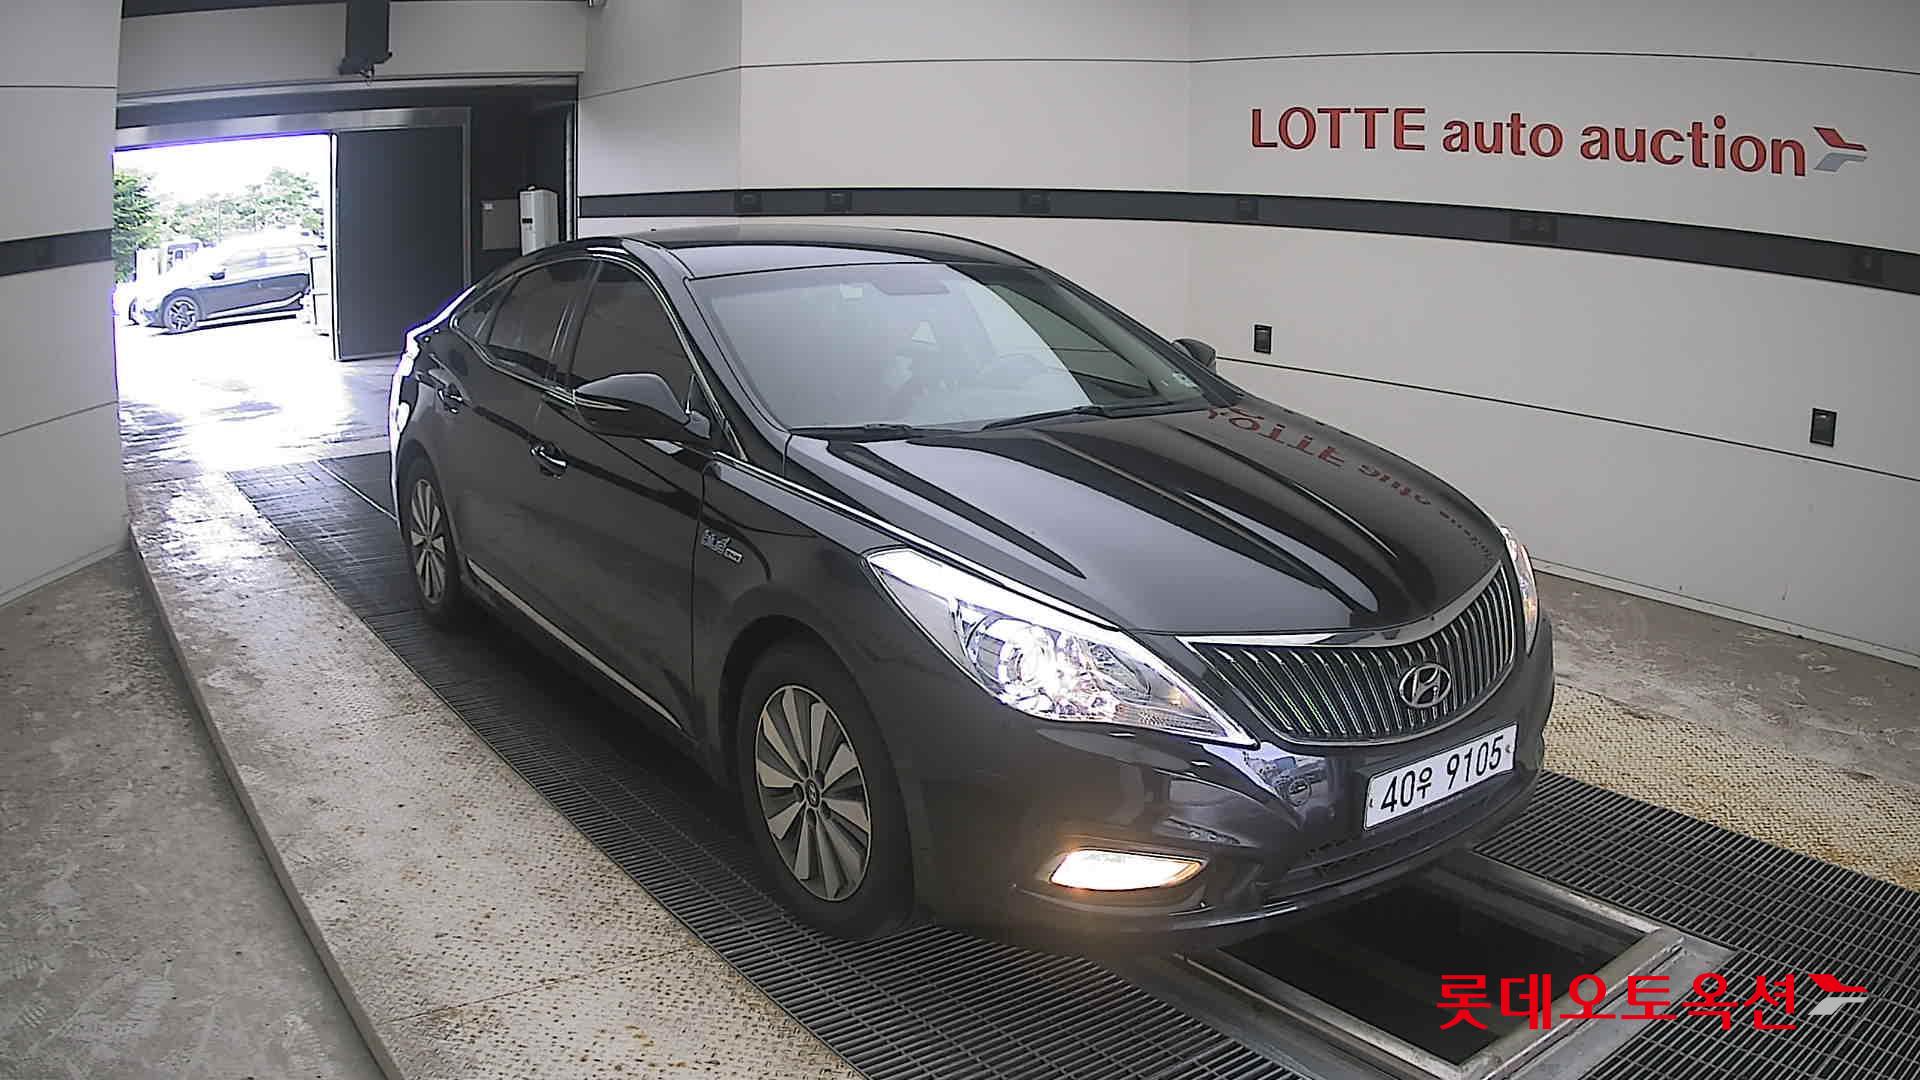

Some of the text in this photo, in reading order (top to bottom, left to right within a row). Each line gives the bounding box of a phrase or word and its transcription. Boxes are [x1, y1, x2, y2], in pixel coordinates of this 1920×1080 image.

[1250, 106, 1808, 177] LOTTE auto auction
[1380, 736, 1504, 813] 40우 9105
